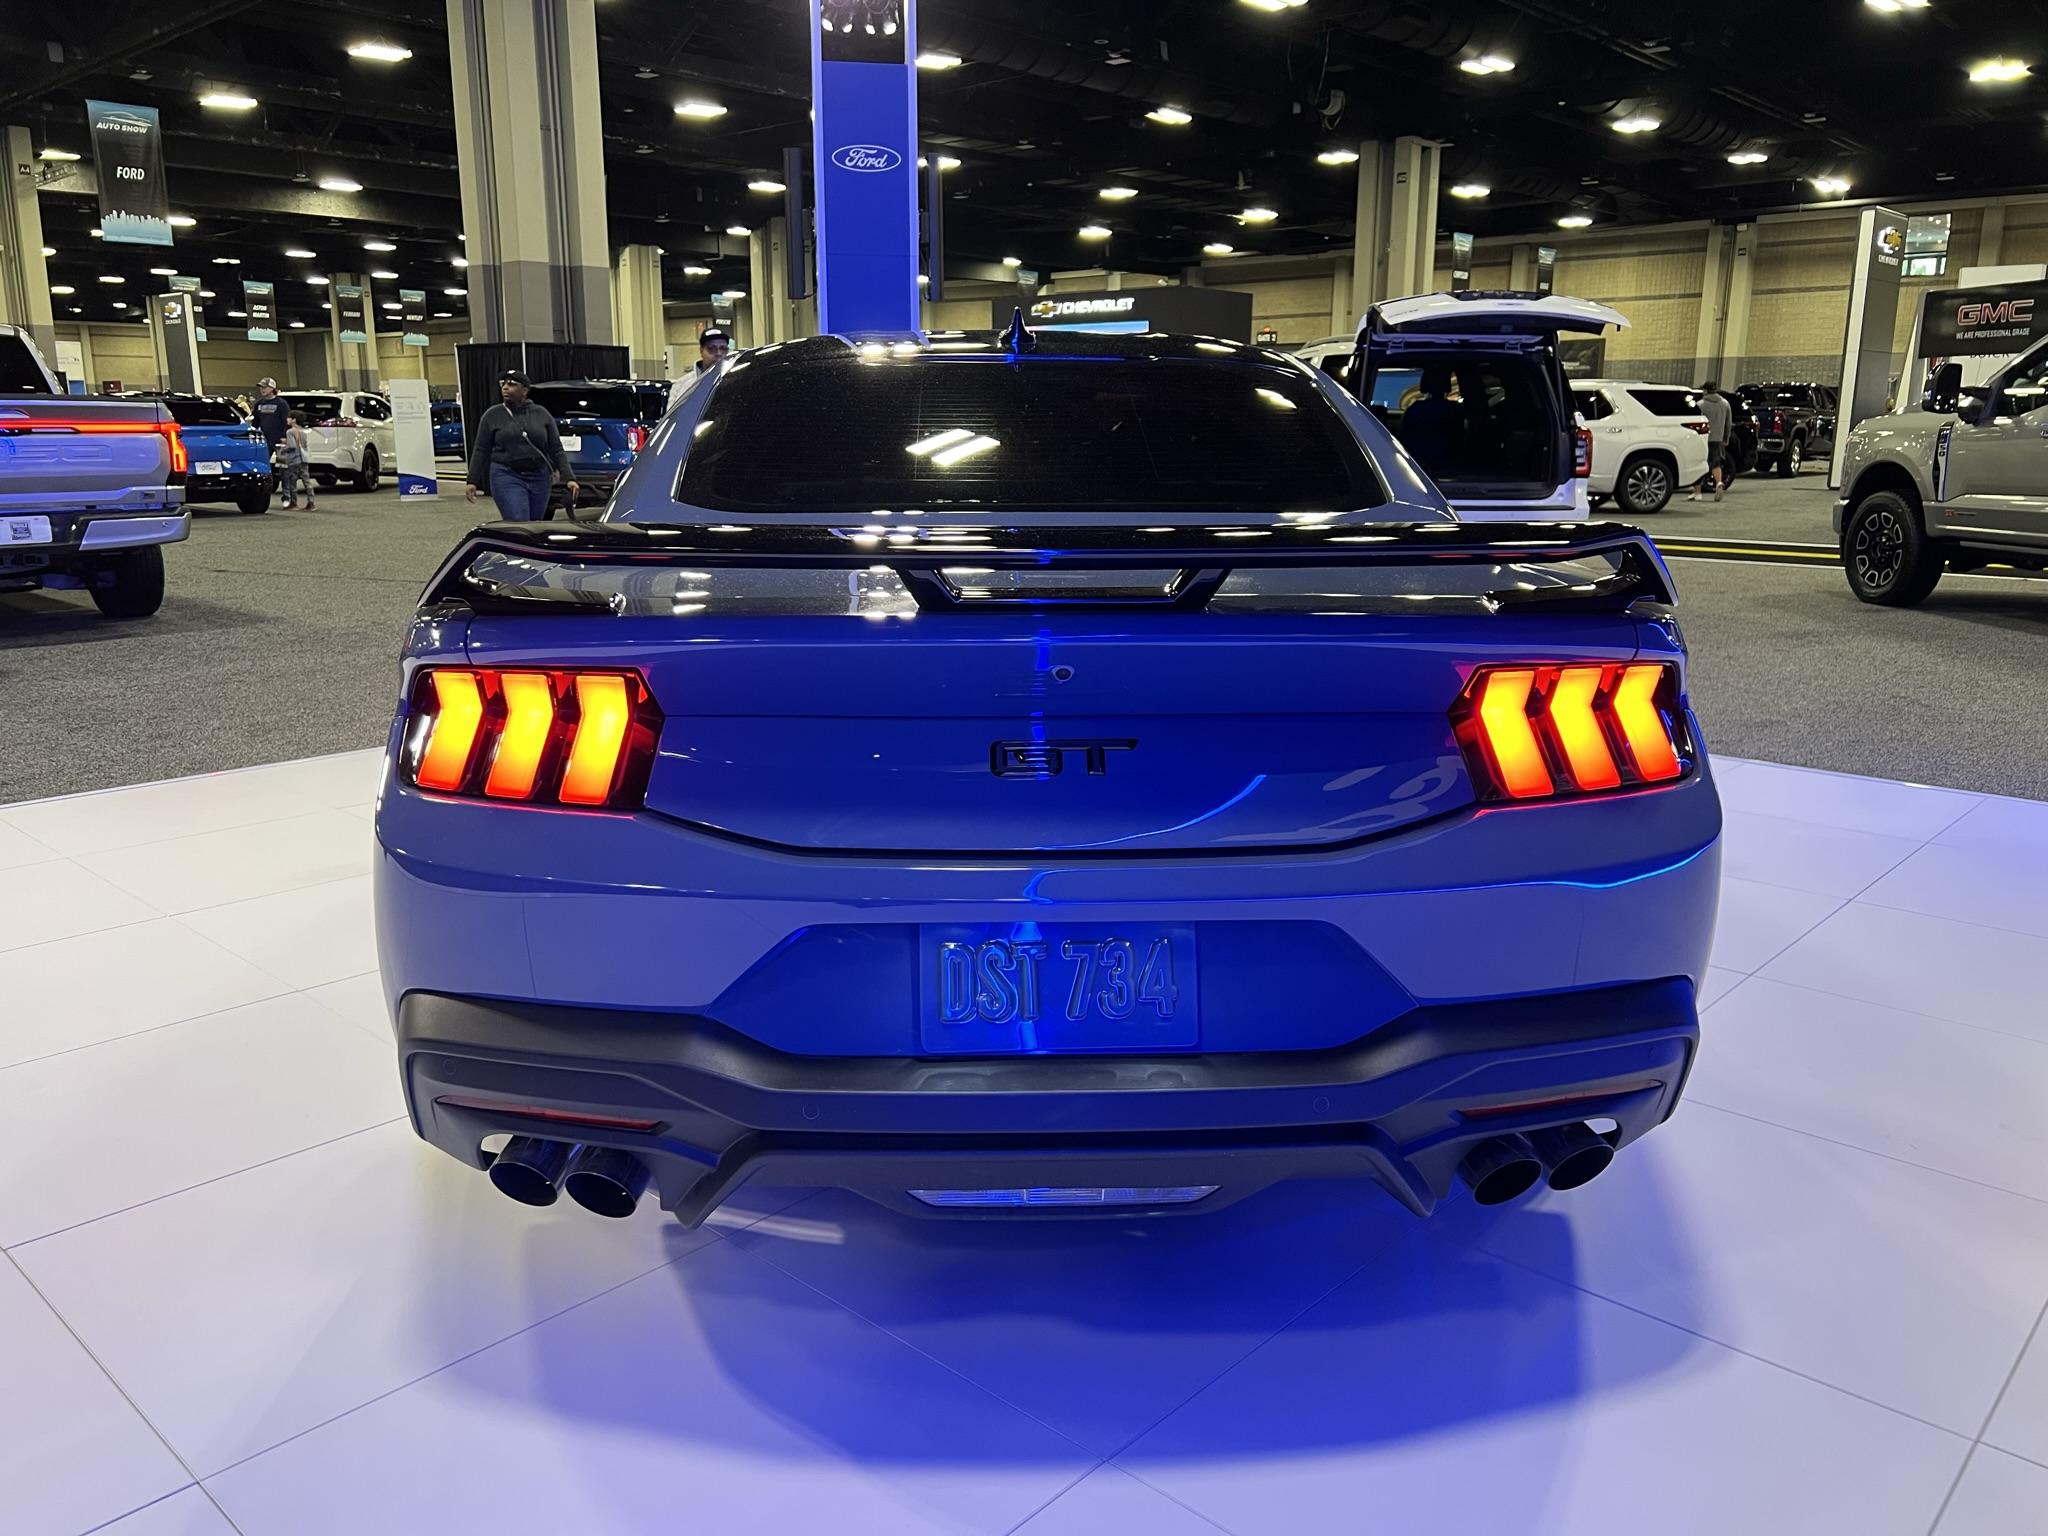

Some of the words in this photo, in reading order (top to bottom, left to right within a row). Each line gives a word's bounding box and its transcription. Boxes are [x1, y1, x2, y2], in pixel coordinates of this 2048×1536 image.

[96, 122, 121, 131] AUTO
[121, 125, 148, 134] SHOW
[845, 147, 888, 168] Ford
[116, 166, 145, 180] FORD
[1062, 298, 1135, 315] CHEVROLET
[1957, 299, 2035, 326] GMC
[1955, 332, 1964, 340] WE
[1964, 331, 1974, 339] ARE
[1974, 328, 2011, 338] PROFESSIONAL
[2012, 327, 2030, 336] GRADE
[408, 484, 428, 494] Ford
[990, 739, 1139, 777] GT
[940, 939, 1047, 1024] DST
[1061, 937, 1178, 1020] 734
